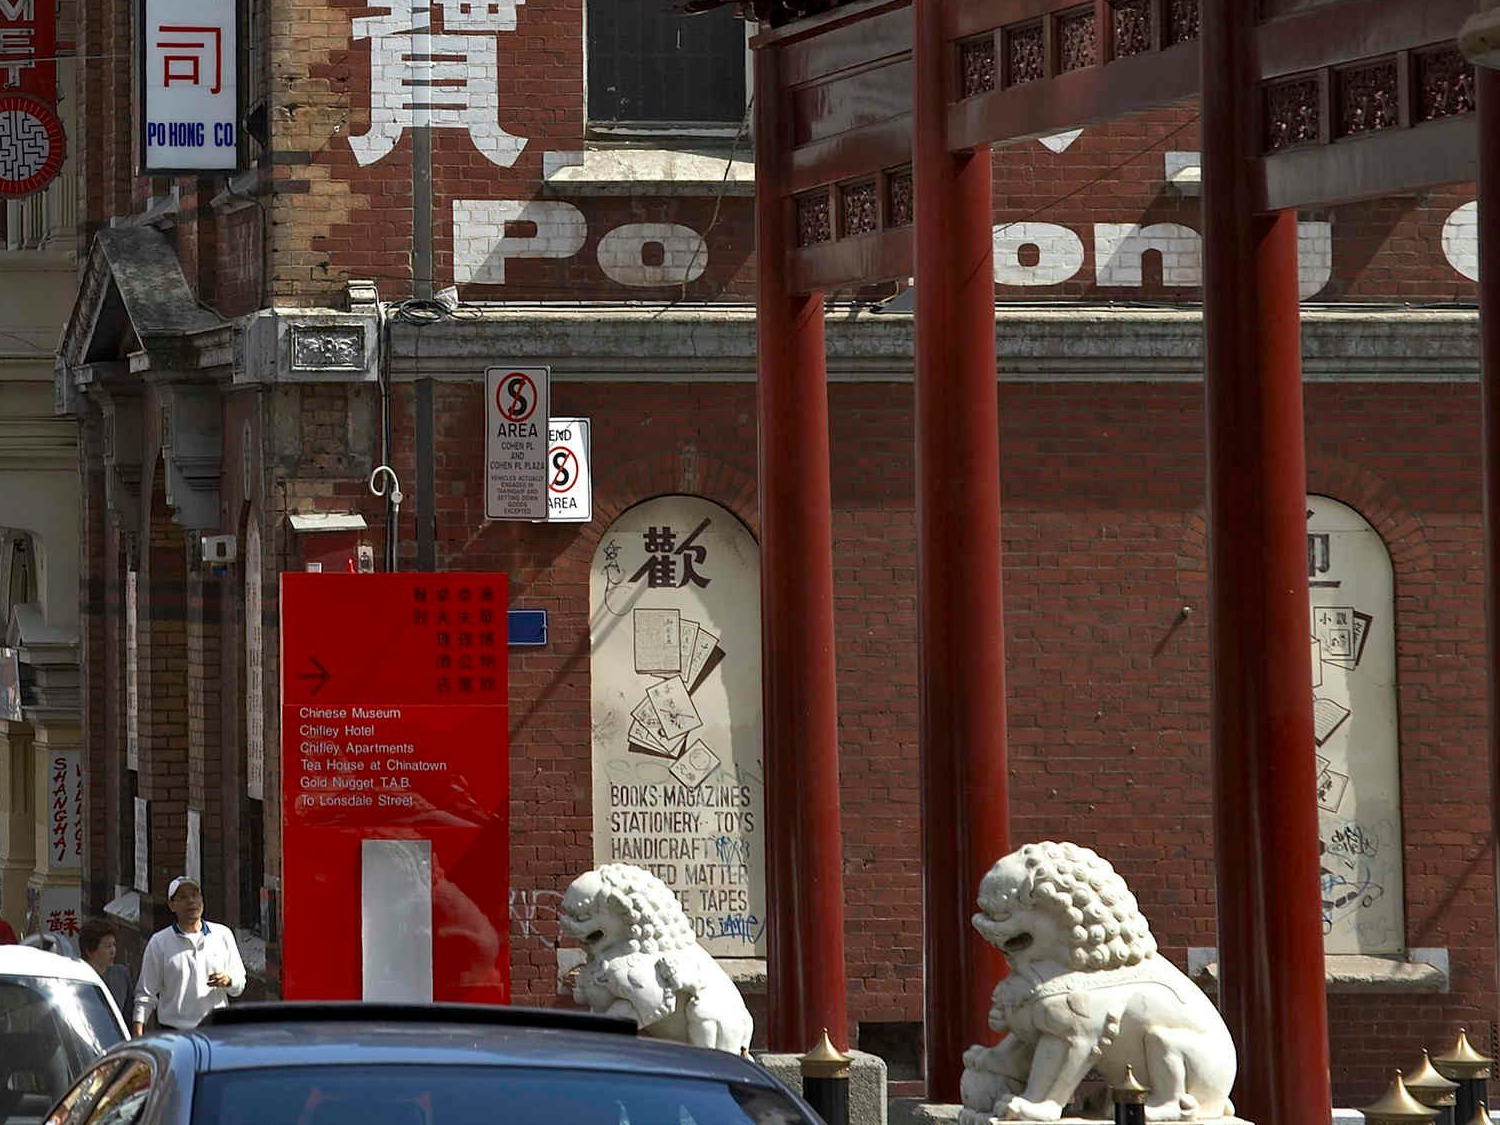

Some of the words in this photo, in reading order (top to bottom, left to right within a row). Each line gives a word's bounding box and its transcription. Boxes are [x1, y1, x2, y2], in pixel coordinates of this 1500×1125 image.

[148, 122, 166, 147] PO
[168, 122, 204, 147] HONG
[452, 199, 710, 287] Po
[497, 423, 538, 437] AREA
[549, 429, 572, 442] END
[300, 707, 347, 719] Chinese
[352, 707, 401, 719] Museum
[300, 725, 339, 738] Chifley
[345, 725, 375, 736] Hotel
[300, 742, 340, 756] Chifley
[346, 743, 414, 756] Apartments
[301, 759, 322, 771] Tea
[326, 759, 365, 771] House
[370, 760, 381, 771] at
[386, 759, 447, 771] Chinatown
[300, 777, 327, 788] Gold
[332, 777, 374, 791] Nugget
[301, 795, 315, 807] To
[319, 795, 373, 807] Lonsdale
[378, 795, 413, 807] Street
[52, 757, 68, 862] SHANGHAI
[714, 811, 755, 834] TOYS
[684, 863, 749, 886] MATTER
[700, 890, 748, 912] TAPES
